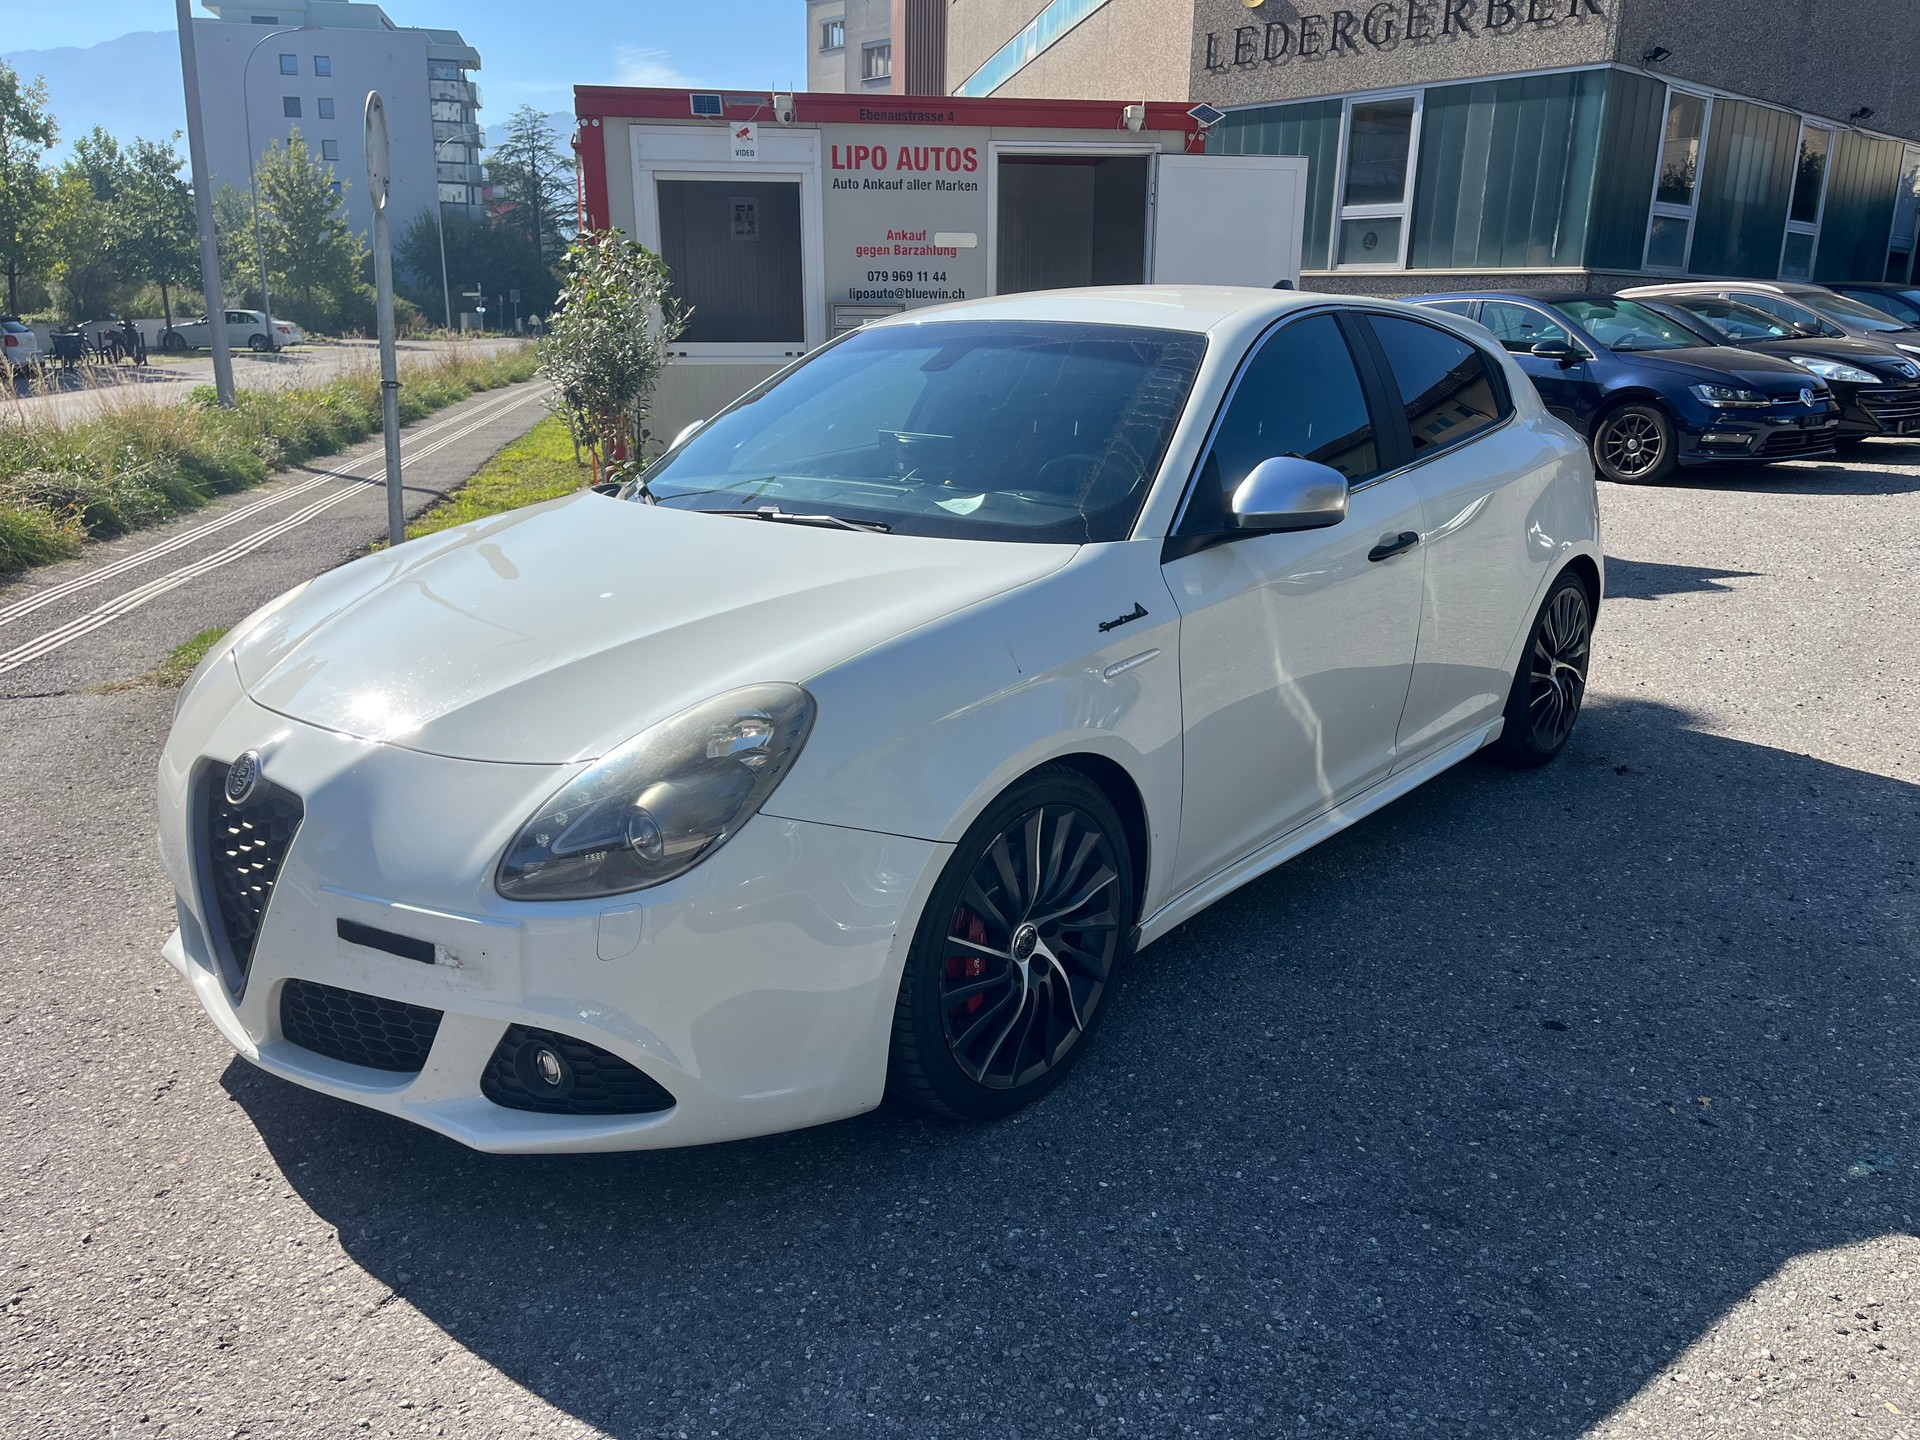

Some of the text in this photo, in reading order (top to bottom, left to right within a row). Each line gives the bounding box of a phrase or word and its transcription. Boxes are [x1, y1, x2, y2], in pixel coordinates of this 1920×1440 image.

[859, 108, 955, 122] Ebenaustrasse 4
[735, 149, 755, 157] VIDEO
[831, 145, 978, 172] LIPO AUTOS
[832, 177, 978, 192] Auto Ankauf aller Marken
[886, 229, 927, 241] Ankauf
[856, 244, 957, 259] gegen Barzahlung
[867, 270, 947, 282] 079 969 11 44
[849, 287, 965, 301] lipoauto@bluewin.ch
